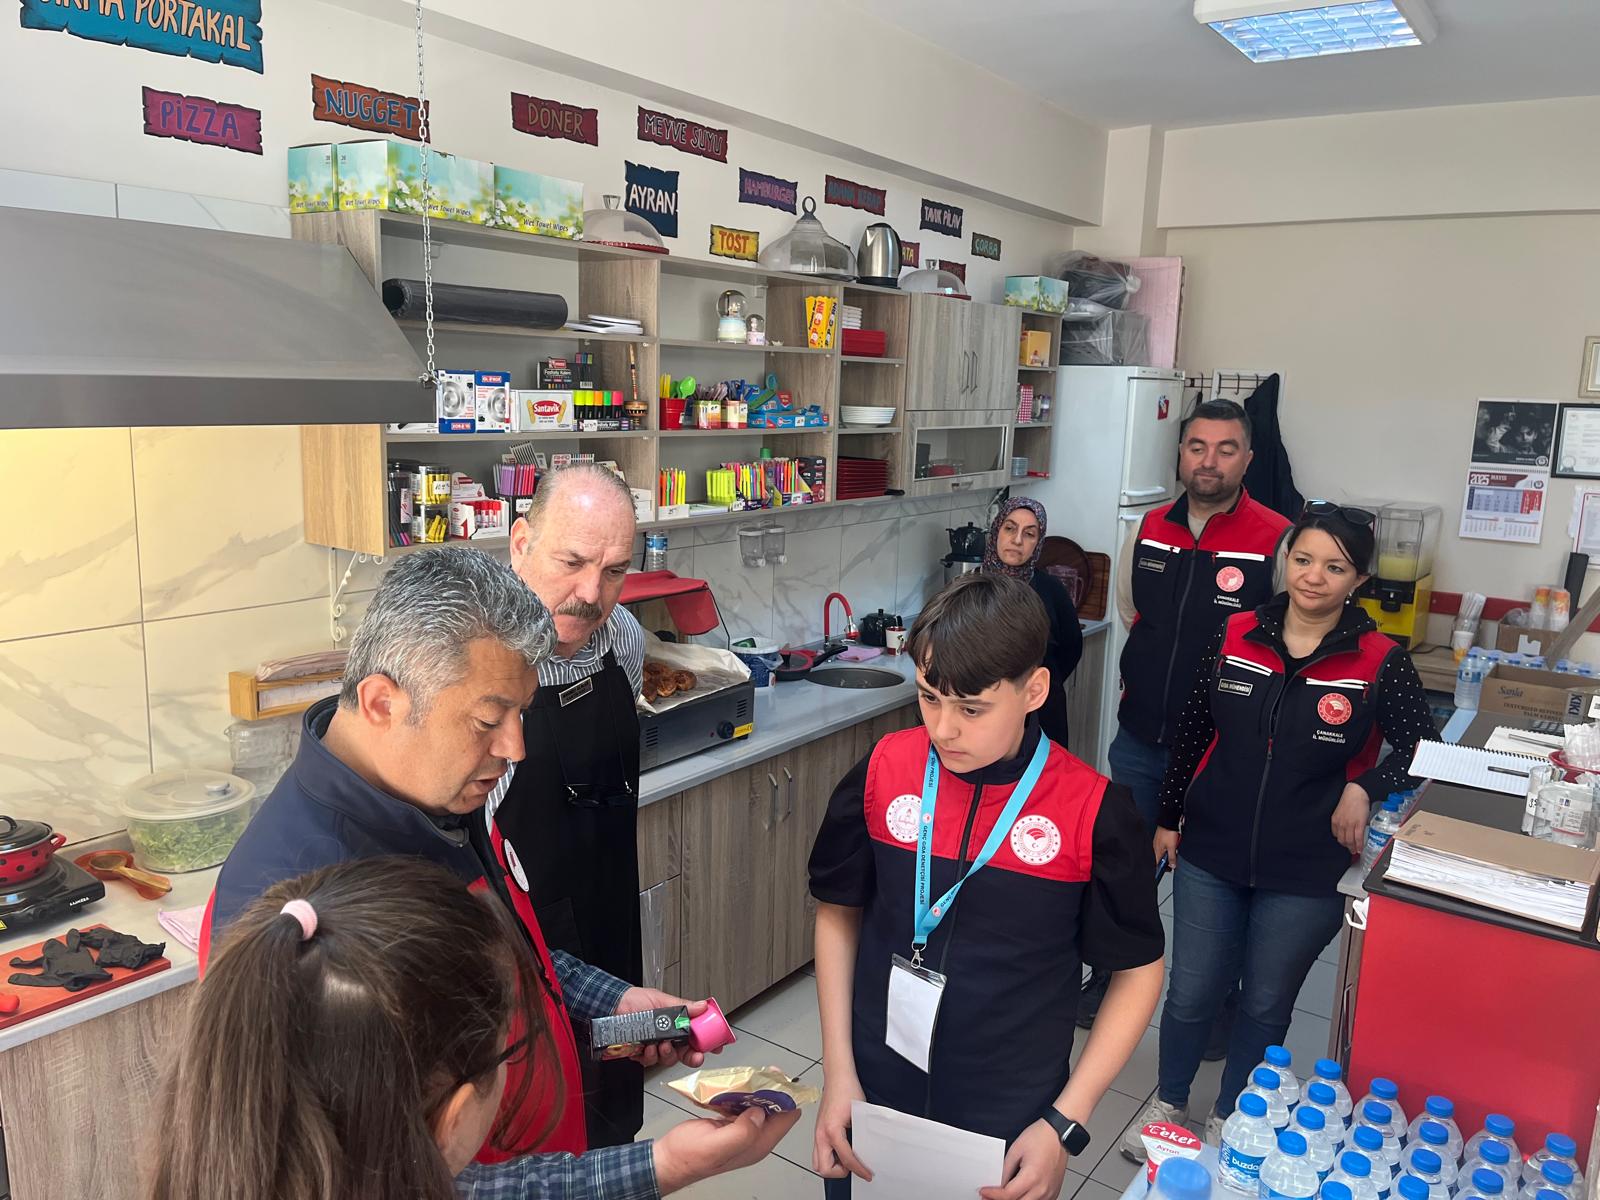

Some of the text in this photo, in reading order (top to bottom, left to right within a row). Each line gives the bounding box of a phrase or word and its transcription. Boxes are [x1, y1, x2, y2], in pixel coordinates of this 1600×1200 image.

[135, 0, 251, 51] PORTAKAL
[325, 88, 418, 130] NUGGET
[527, 101, 585, 137] DÖNER
[644, 113, 722, 155] MEYVE SUYU
[629, 183, 676, 215] AYRAN
[523, 218, 569, 232] Wet Towel Wipes
[719, 230, 750, 253] TOST
[533, 403, 560, 413] Santavik
